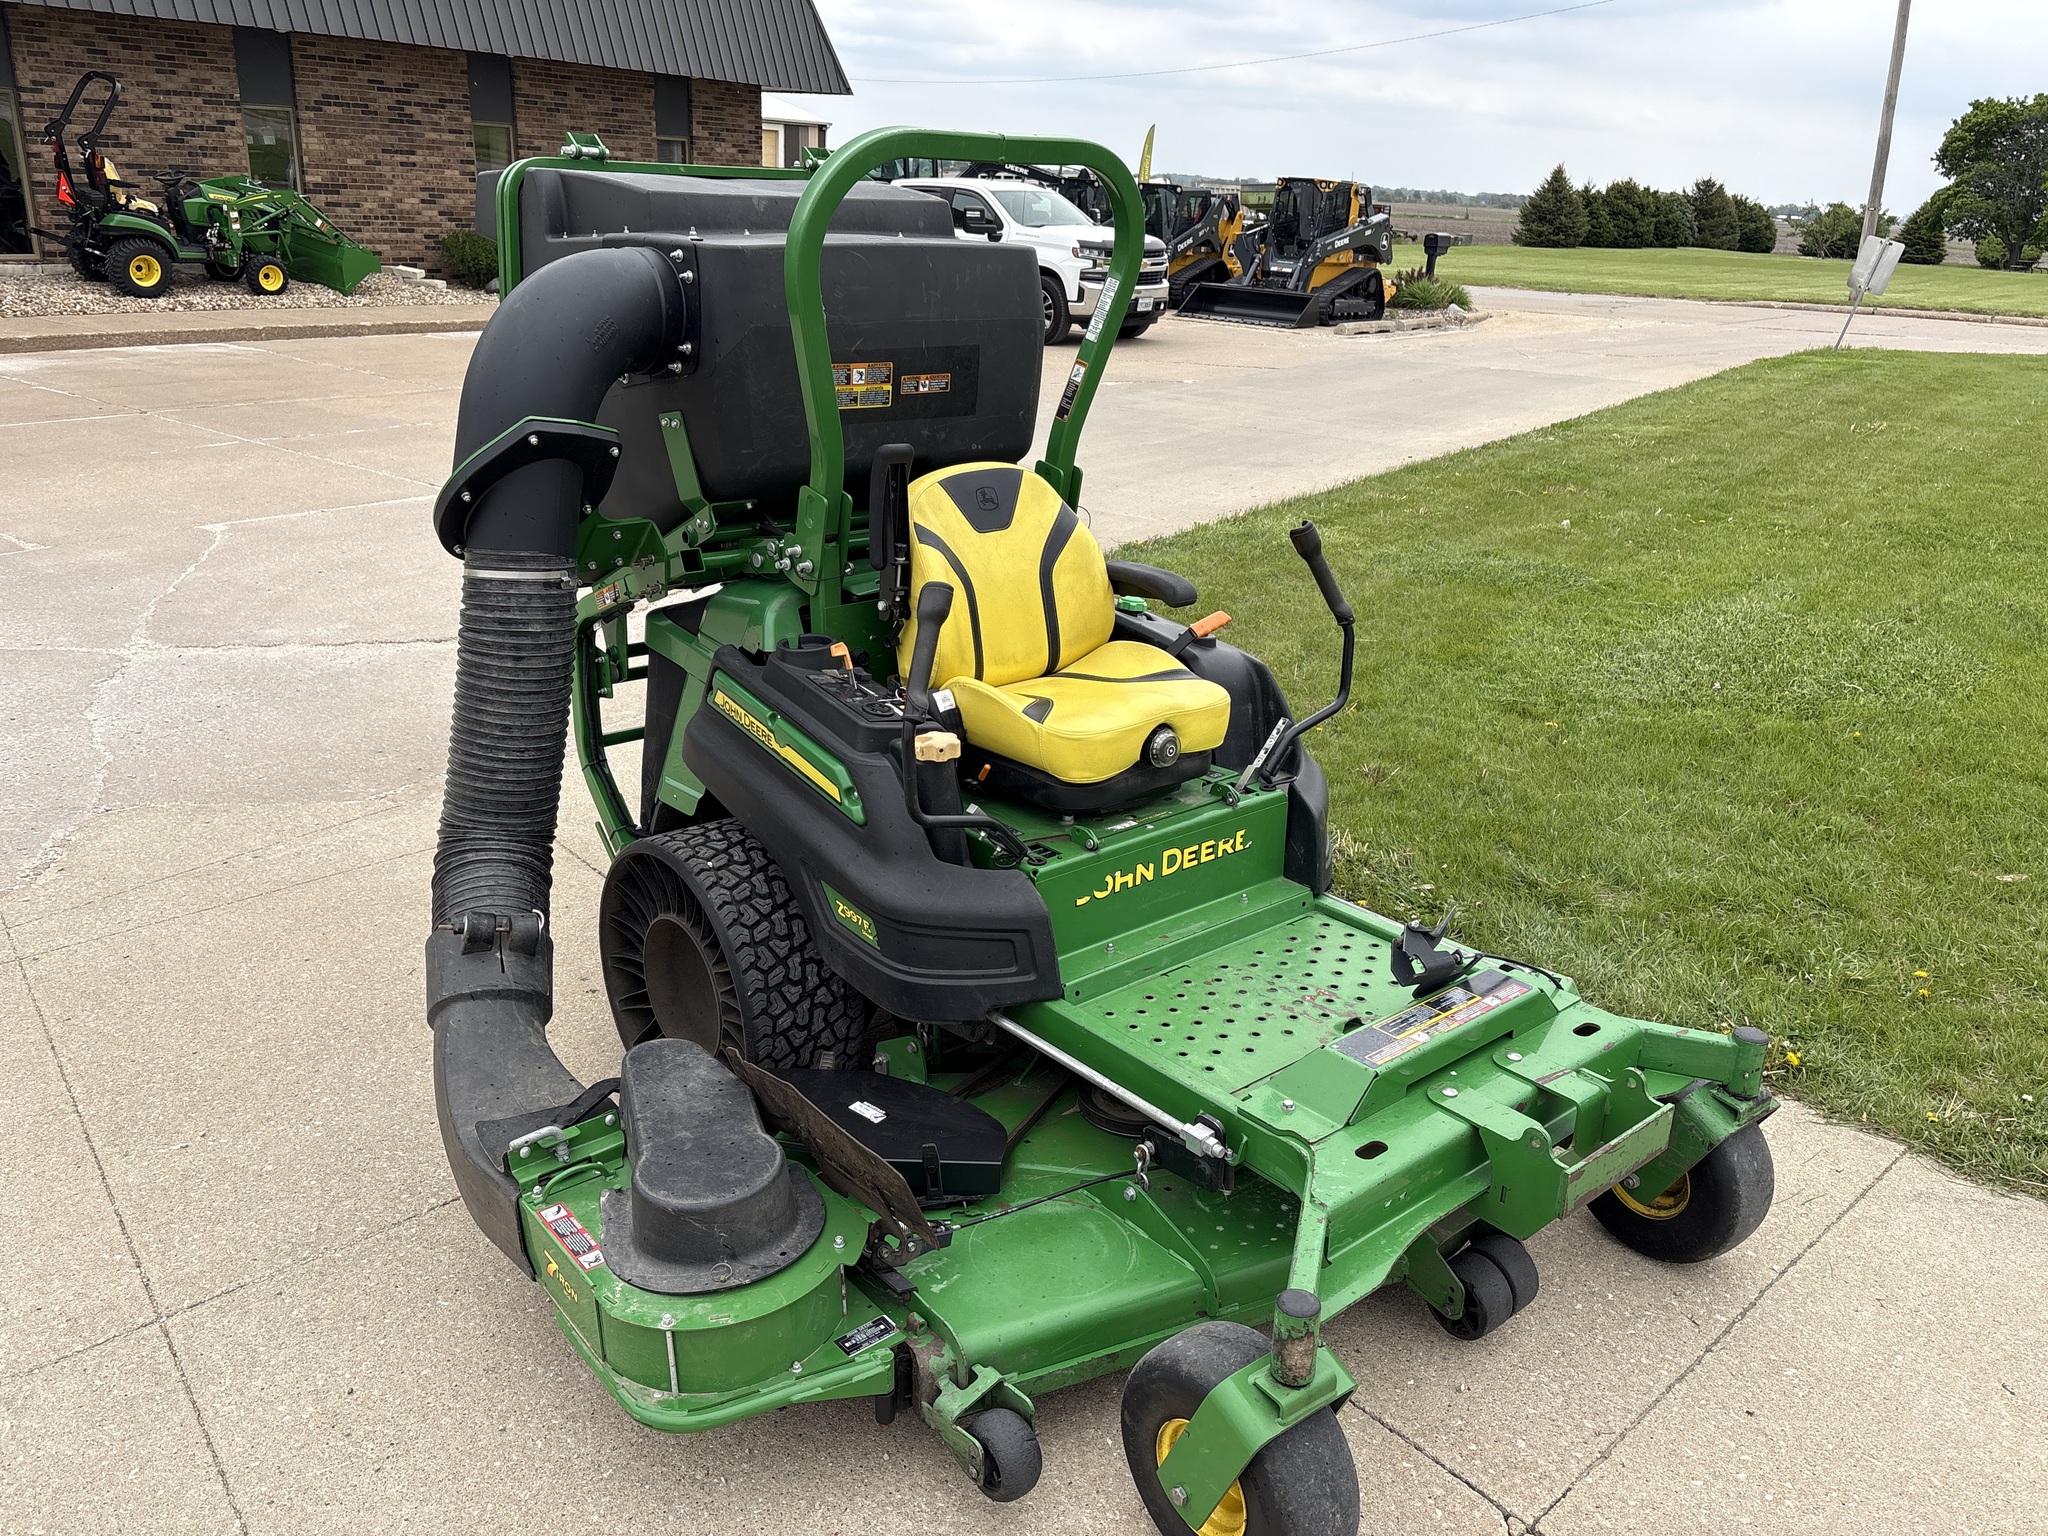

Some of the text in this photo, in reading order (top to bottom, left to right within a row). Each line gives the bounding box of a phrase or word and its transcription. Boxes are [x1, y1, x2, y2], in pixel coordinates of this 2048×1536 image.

[1177, 236, 1194, 252] DEERE
[1334, 237, 1350, 249] DEERE
[720, 695, 774, 747] JOHN DEERE
